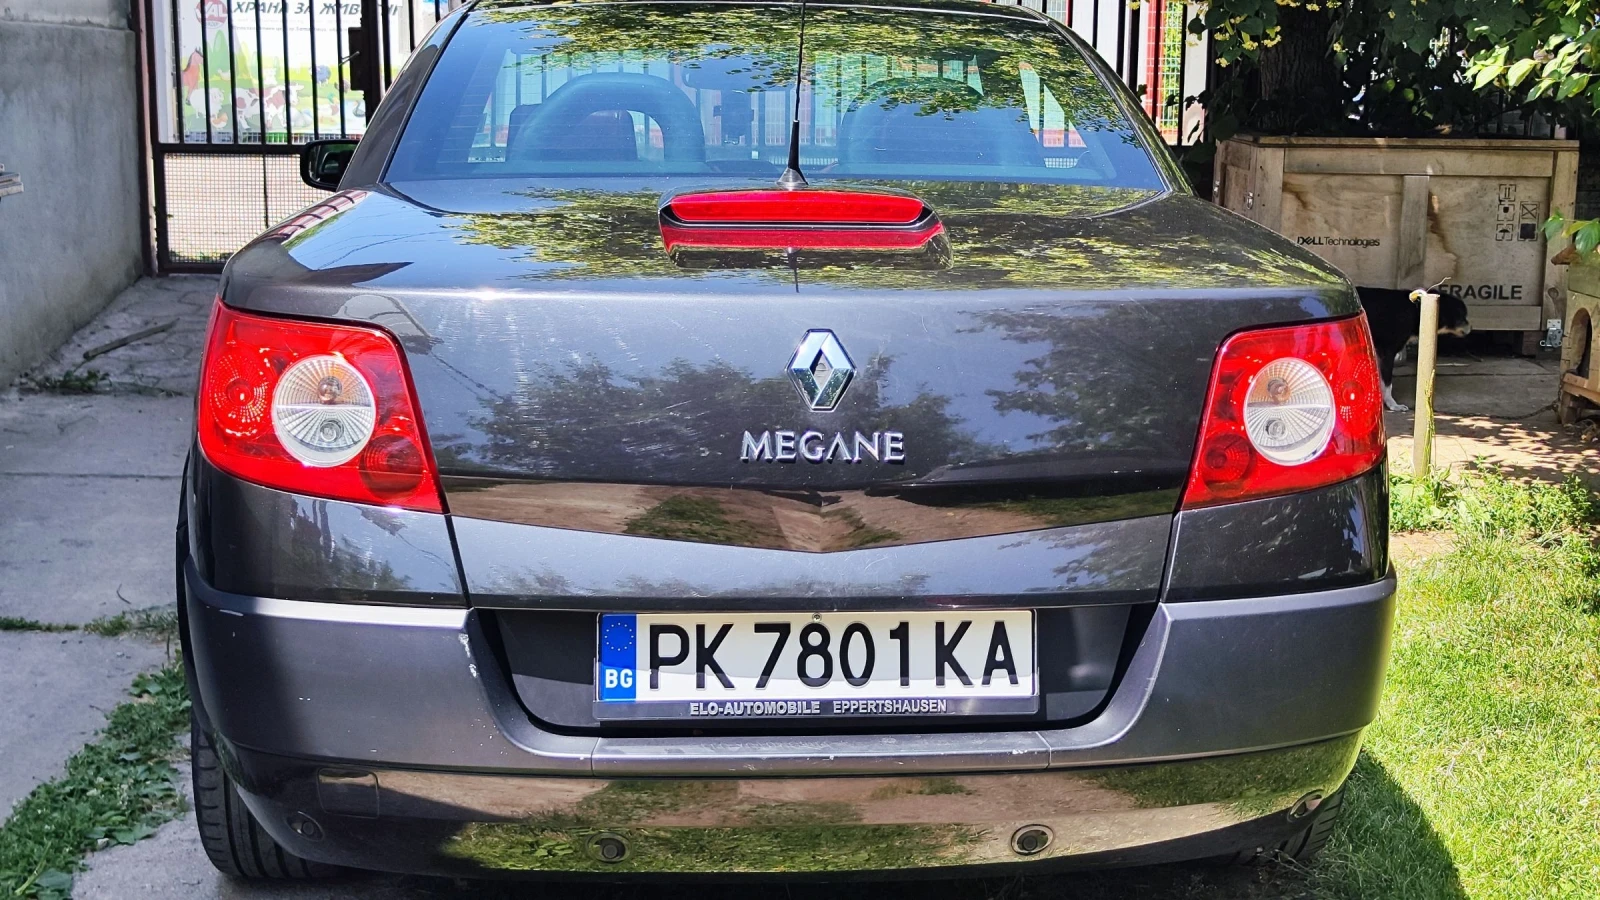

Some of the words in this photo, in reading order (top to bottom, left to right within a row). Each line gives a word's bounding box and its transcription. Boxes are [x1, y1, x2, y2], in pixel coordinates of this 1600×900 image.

[1297, 236, 1324, 246] DELL
[1324, 236, 1381, 248] Technologies
[1438, 284, 1523, 300] FRAGILE
[740, 430, 906, 465] MEGANE
[649, 623, 736, 689] PK
[754, 621, 910, 689] 7801
[934, 620, 1019, 688] KA
[605, 668, 633, 689] BG
[689, 700, 821, 716] ELO-AUTOMOBILE
[833, 699, 947, 714] EPPERTSHAUSEN
